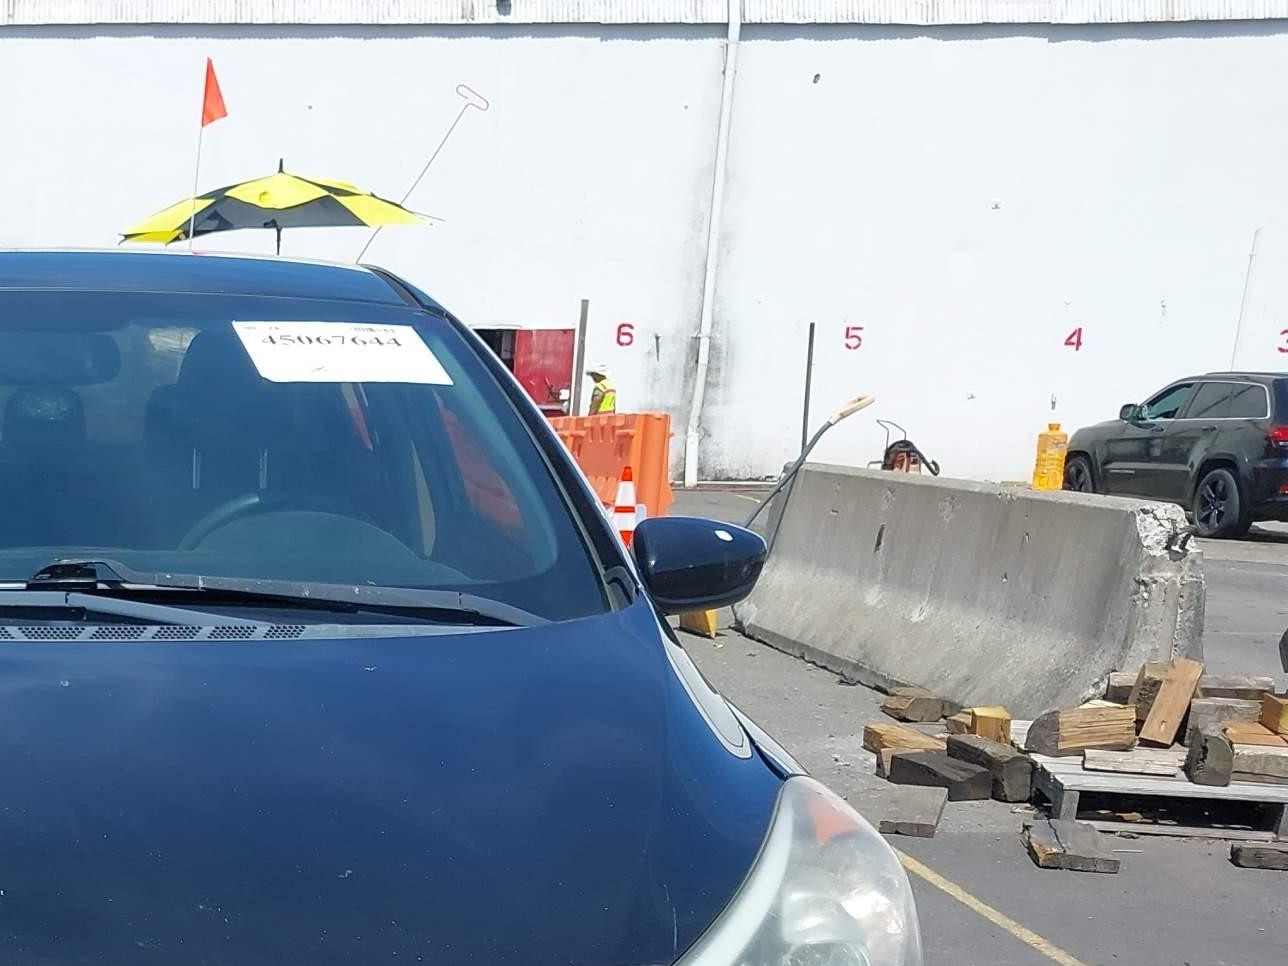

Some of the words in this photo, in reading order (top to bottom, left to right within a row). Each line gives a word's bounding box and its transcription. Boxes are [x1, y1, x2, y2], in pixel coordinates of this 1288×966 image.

[261, 334, 403, 347] 45067644
[616, 322, 634, 347] 6
[844, 326, 862, 350] 5
[1063, 327, 1083, 351] 4
